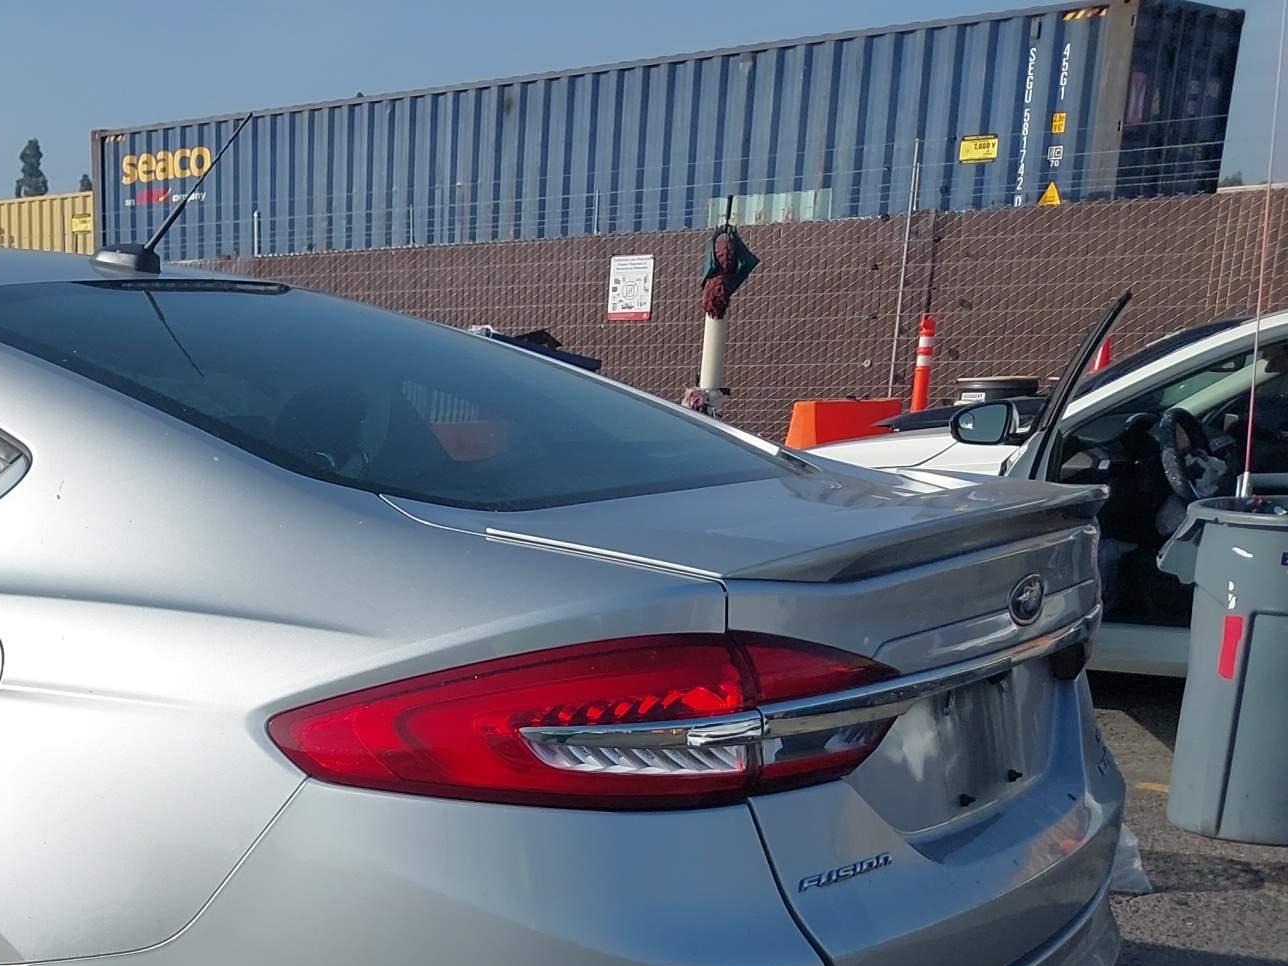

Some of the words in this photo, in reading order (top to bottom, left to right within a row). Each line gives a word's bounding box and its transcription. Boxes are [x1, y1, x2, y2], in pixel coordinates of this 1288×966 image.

[1024, 47, 1037, 103] SEGU
[1059, 43, 1071, 100] 45G1
[121, 146, 212, 185] seaco
[1016, 108, 1031, 191] 581742
